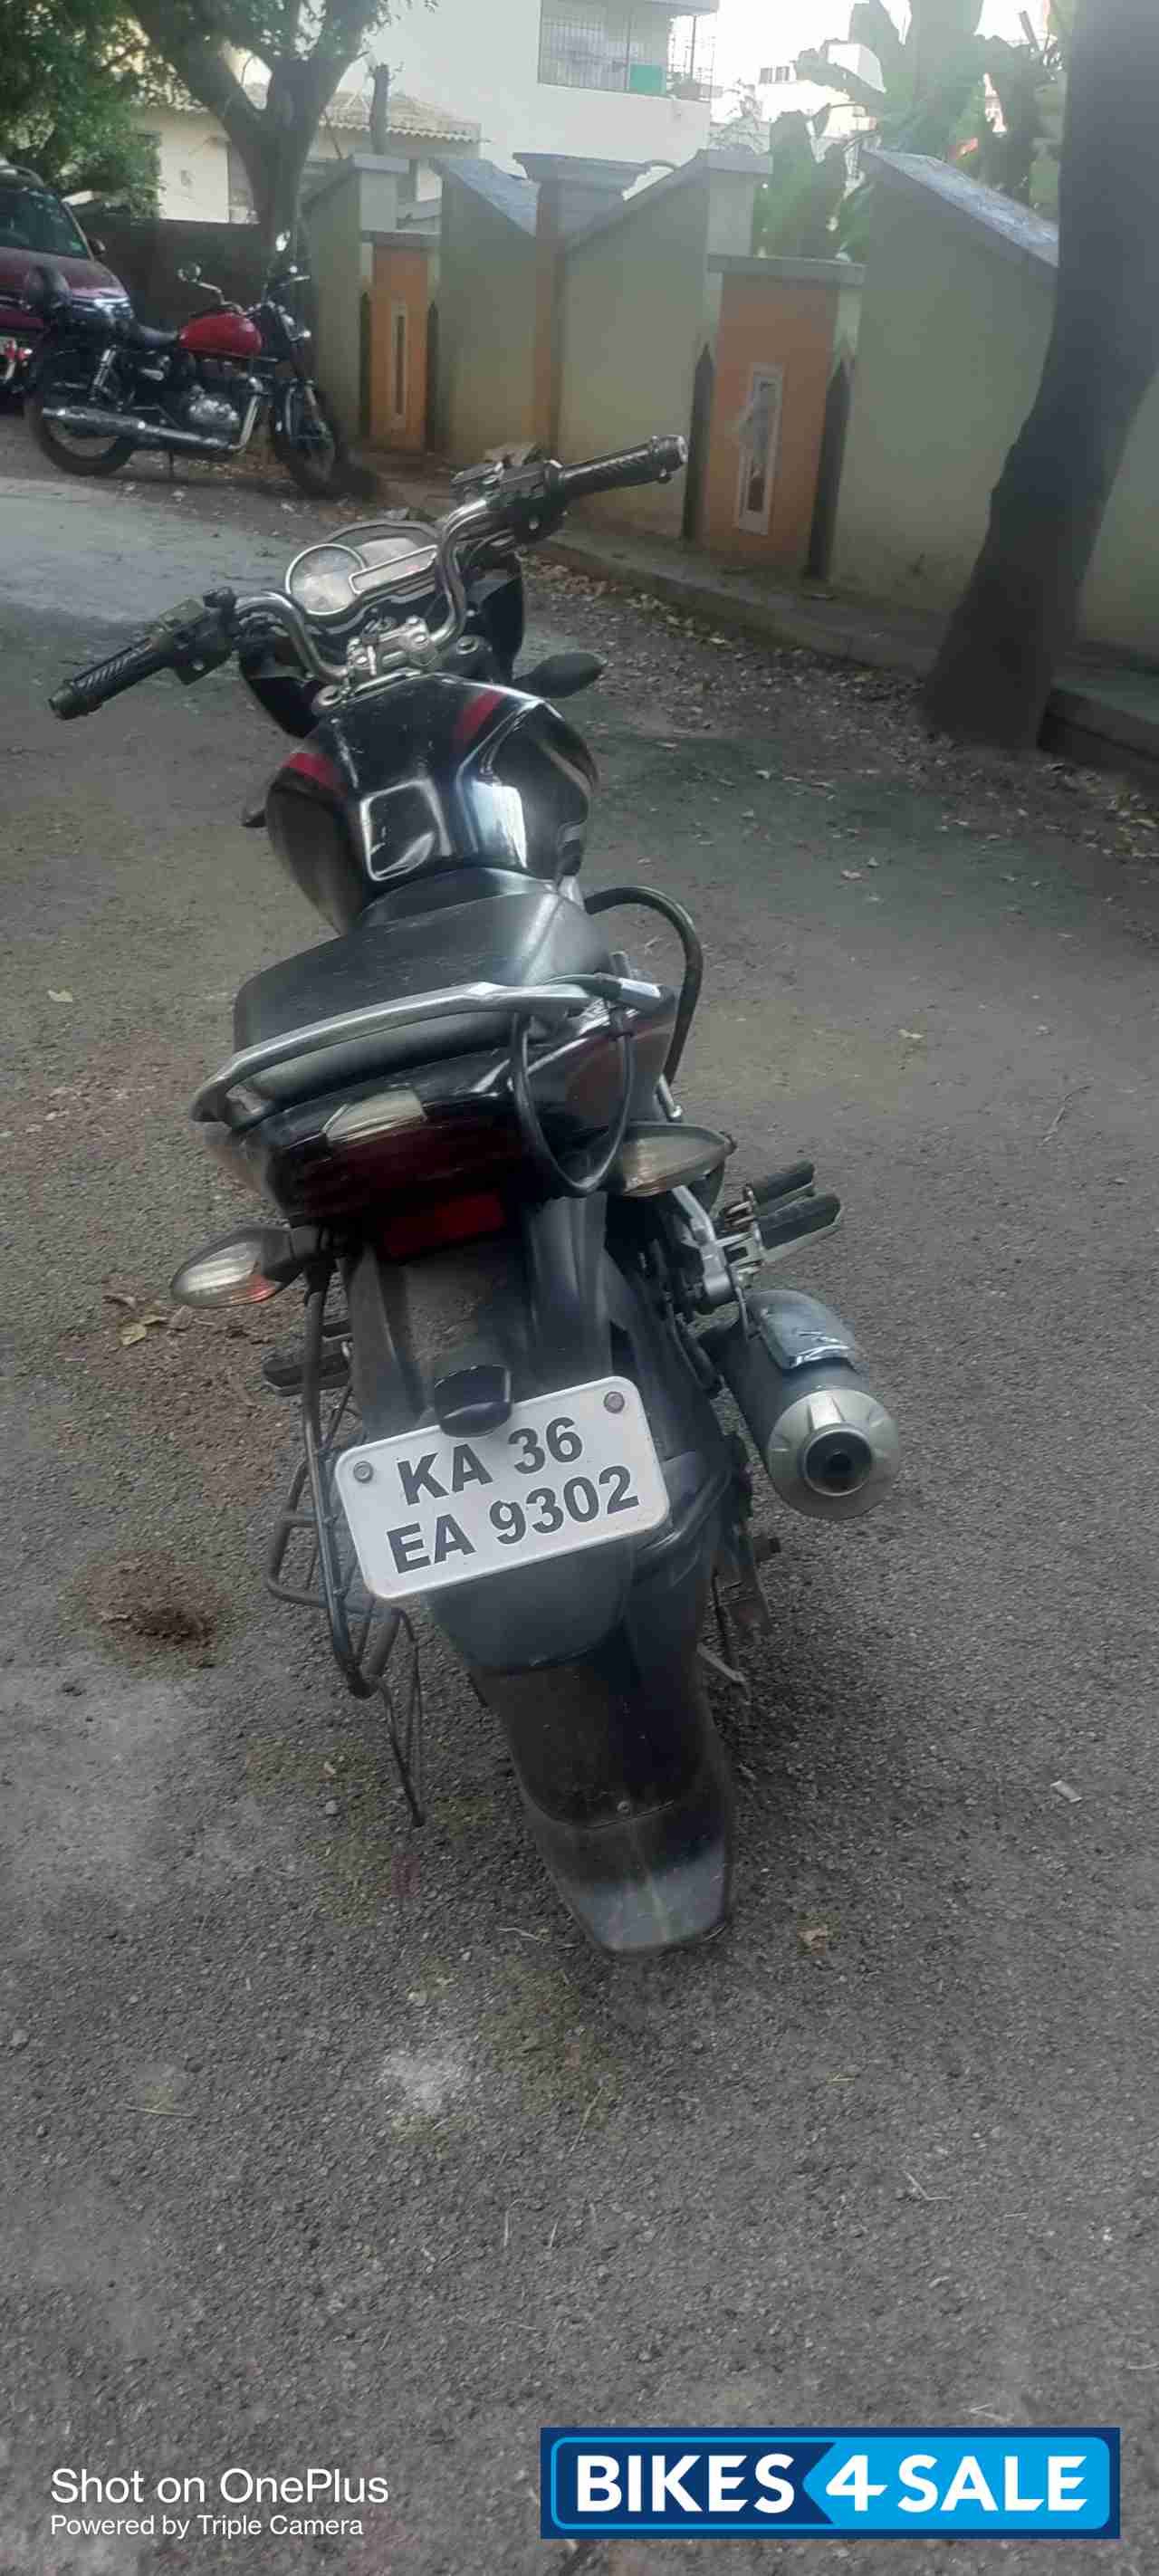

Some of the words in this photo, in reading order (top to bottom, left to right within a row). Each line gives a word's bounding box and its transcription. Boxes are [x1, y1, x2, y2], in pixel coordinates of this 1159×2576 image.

[397, 1443, 493, 1506] KA
[507, 1416, 583, 1474] 36
[386, 1513, 476, 1574] EA
[489, 1465, 639, 1545] 9302
